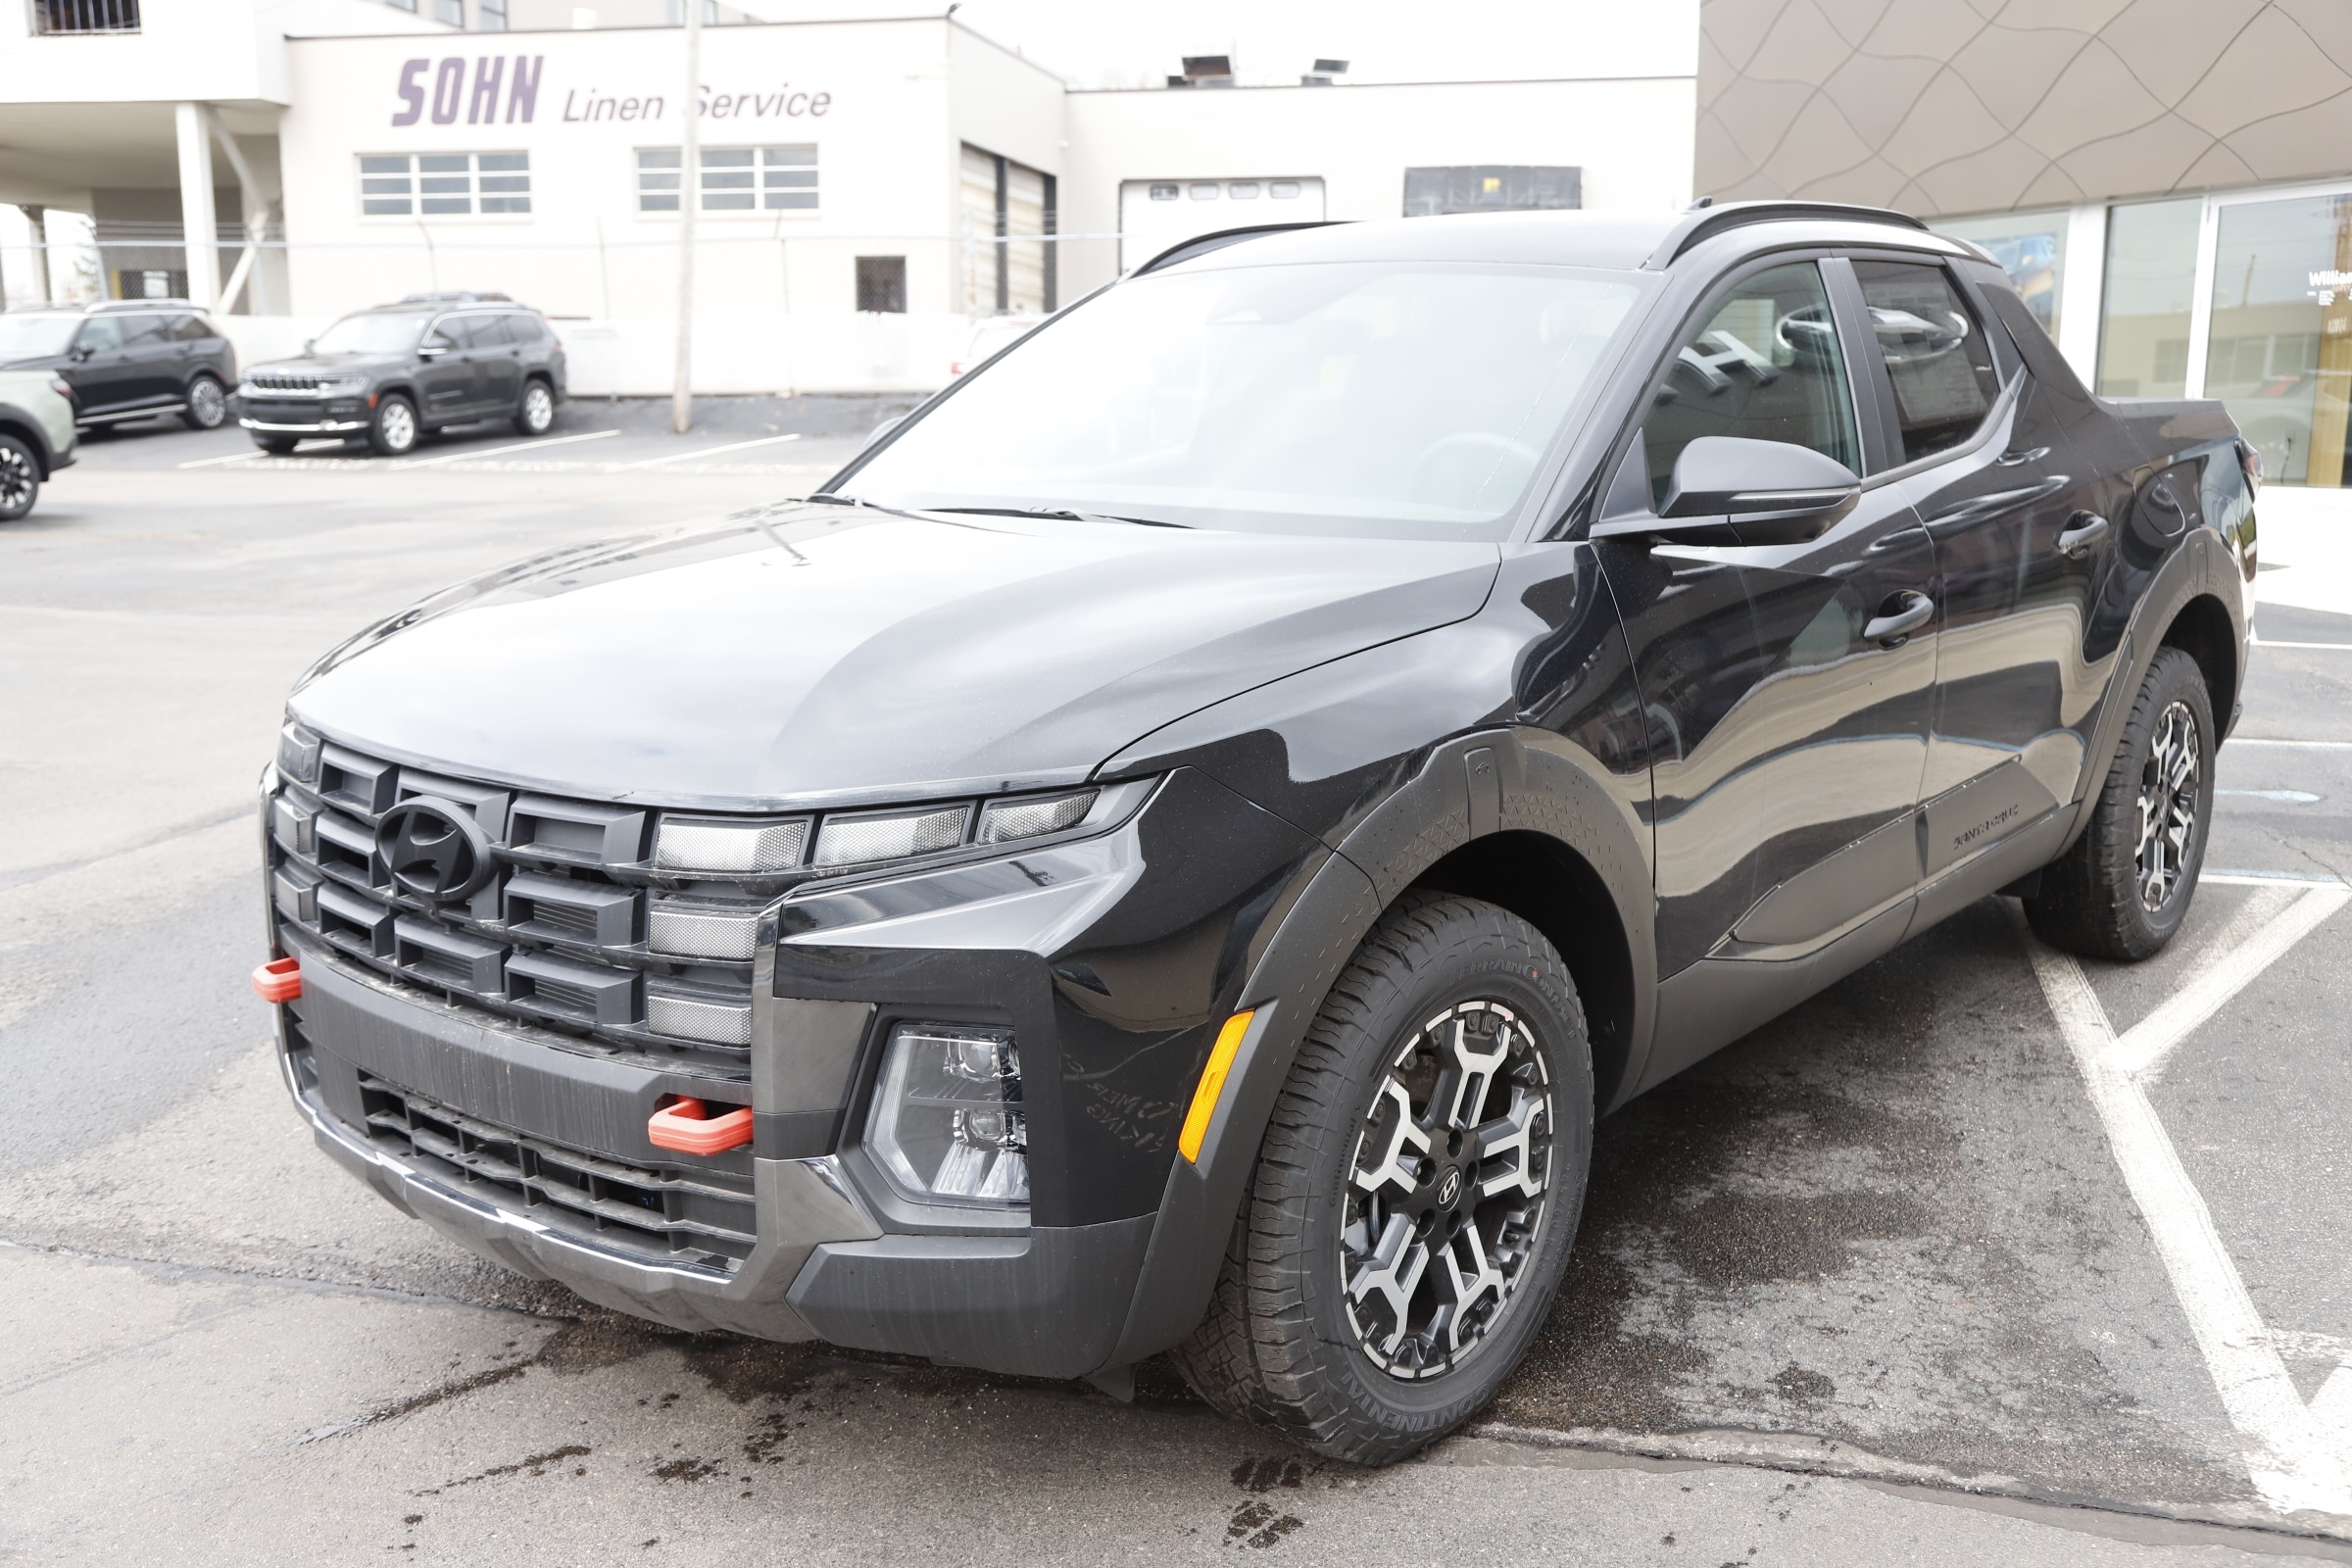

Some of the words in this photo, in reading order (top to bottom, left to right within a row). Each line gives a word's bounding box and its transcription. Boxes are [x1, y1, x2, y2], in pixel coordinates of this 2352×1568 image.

[391, 55, 545, 127] SOHN
[563, 88, 664, 122] Linen
[683, 81, 832, 119] Service
[1340, 1371, 1491, 1433] CONTINENTAL
